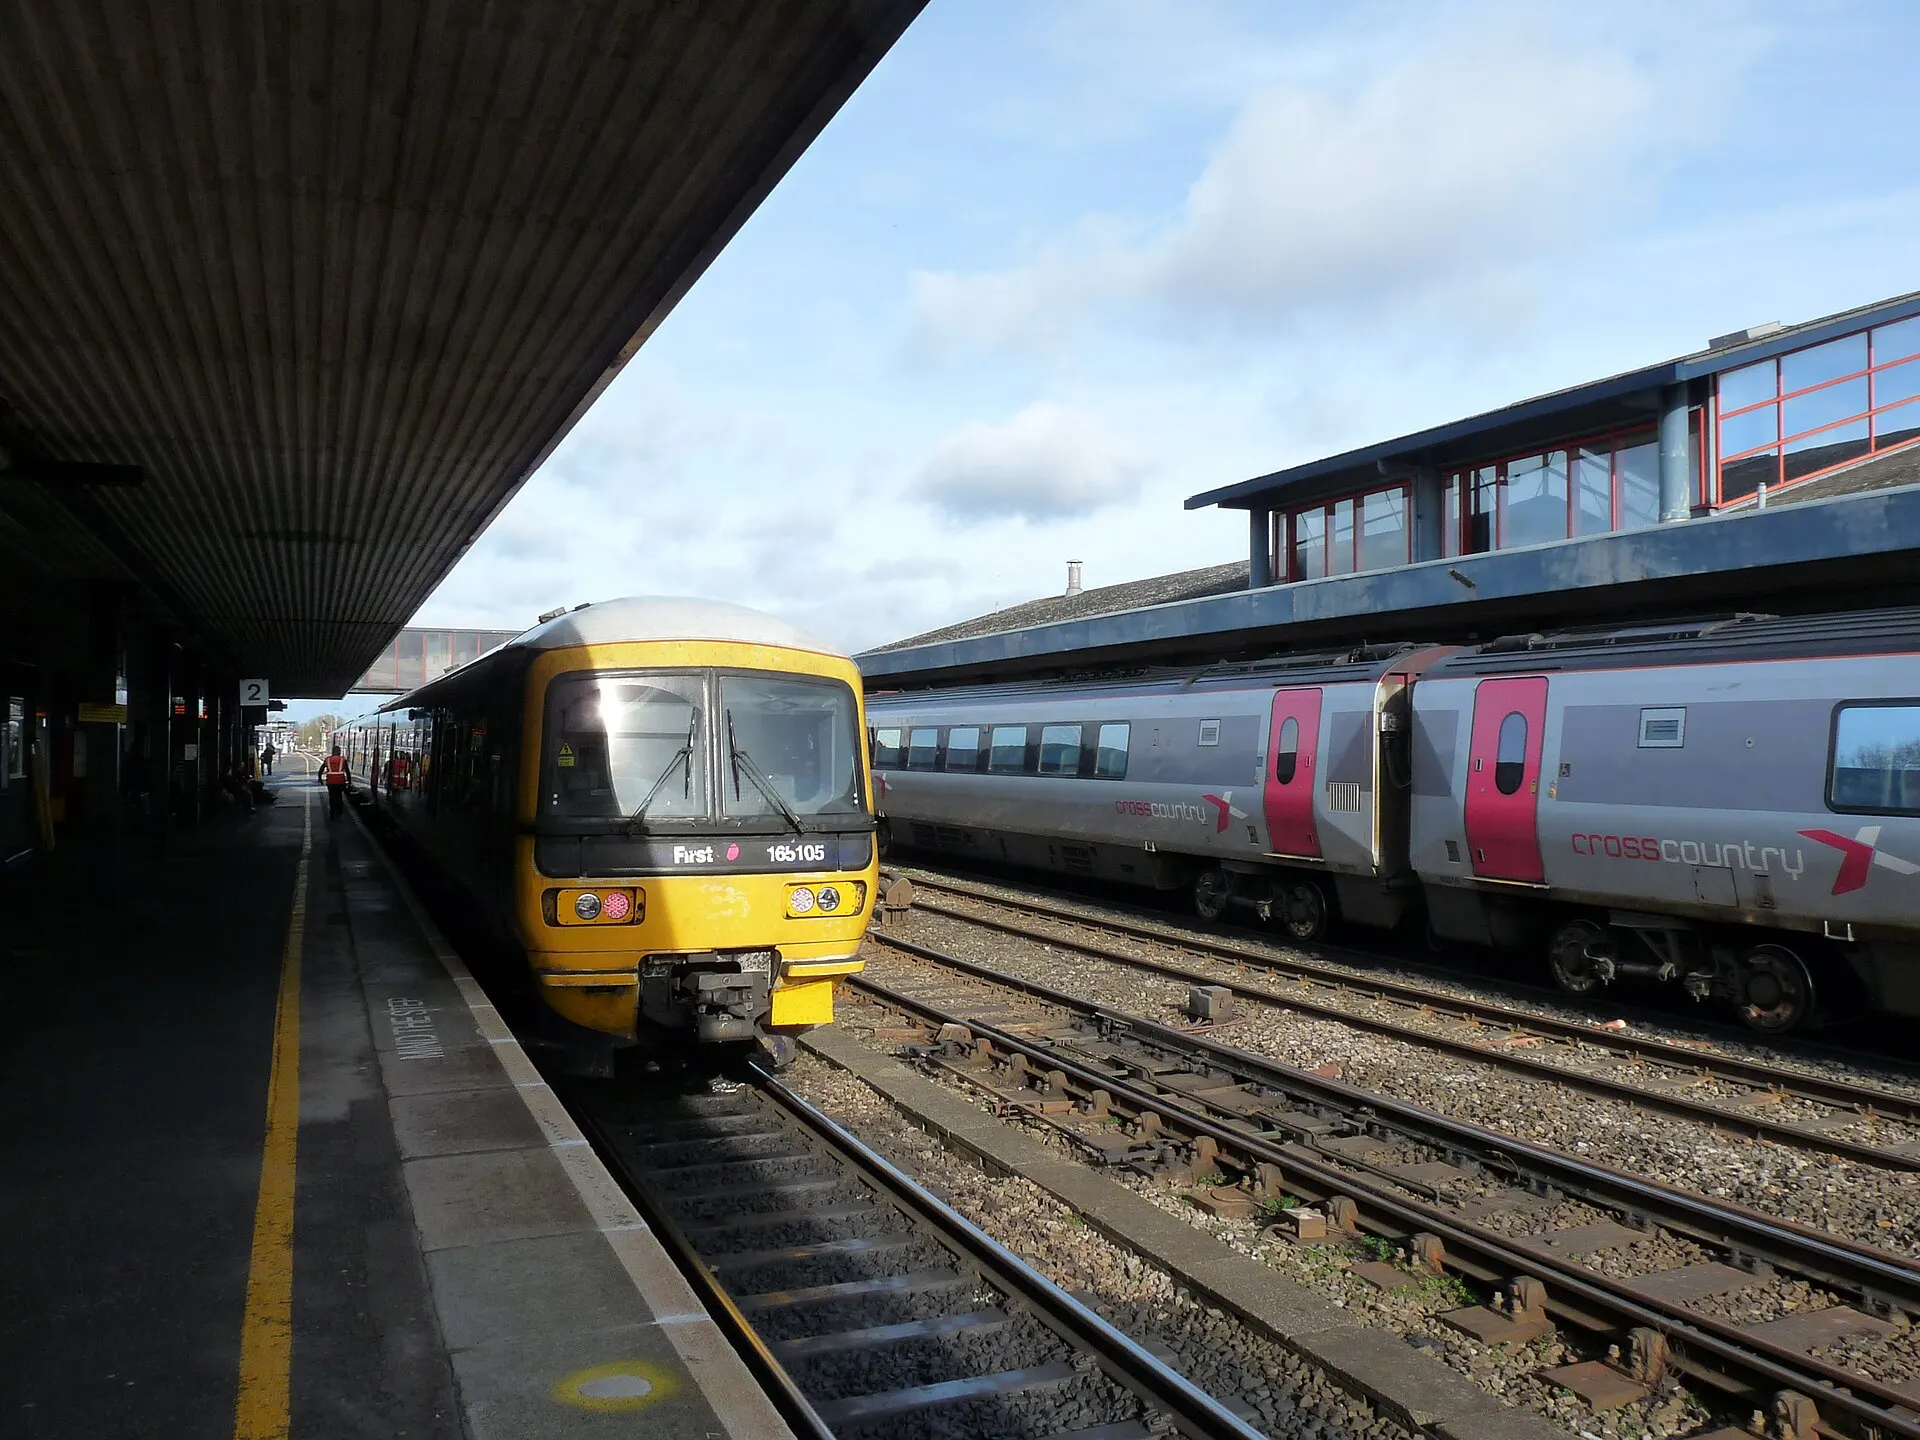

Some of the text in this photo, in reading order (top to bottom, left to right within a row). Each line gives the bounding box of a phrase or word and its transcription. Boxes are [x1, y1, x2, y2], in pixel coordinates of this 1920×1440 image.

[248, 683, 261, 701] 2
[1115, 800, 1208, 825] crosscountry
[674, 845, 714, 864] First
[766, 844, 825, 863] 165105
[1572, 833, 1805, 881] crosscountry
[387, 997, 445, 1061] MIND THE STEP
